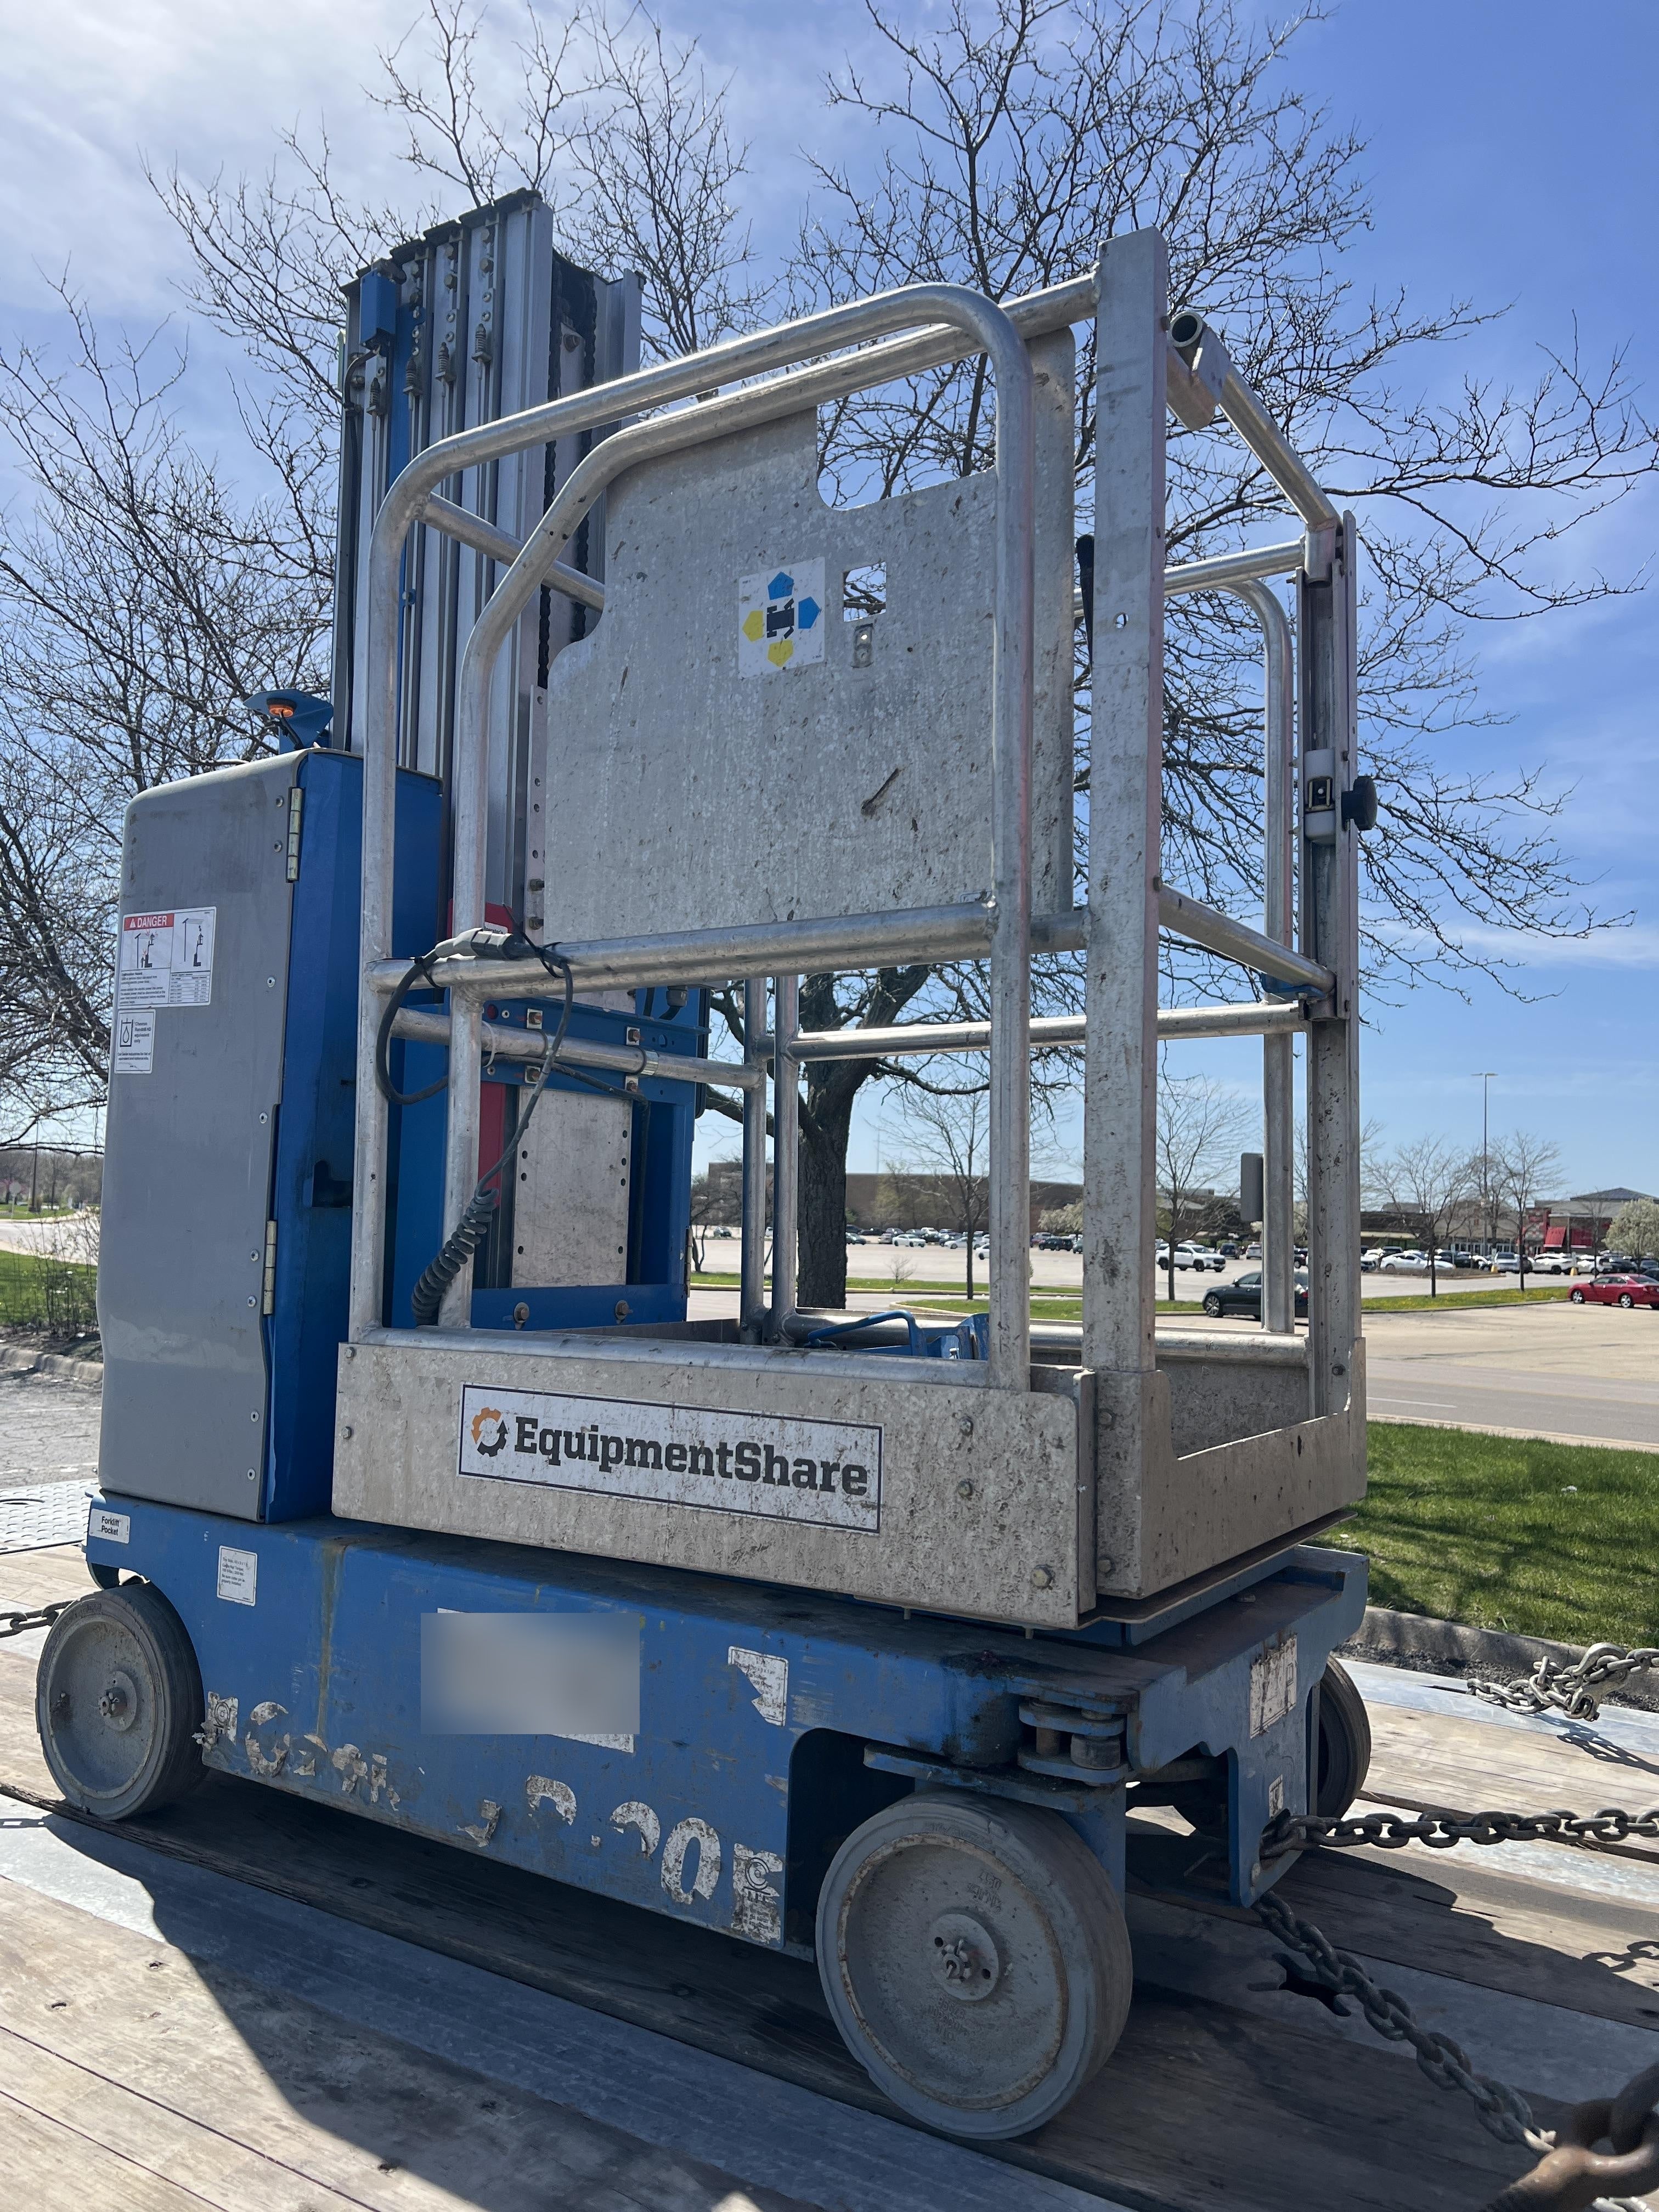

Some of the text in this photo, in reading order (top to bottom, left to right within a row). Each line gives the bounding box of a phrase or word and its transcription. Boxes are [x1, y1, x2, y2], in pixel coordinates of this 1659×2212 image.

[137, 915, 167, 928] DANGER
[514, 1416, 868, 1497] EquipmentShare
[101, 1516, 120, 1527] Forklift
[101, 1525, 119, 1536] Pocket
